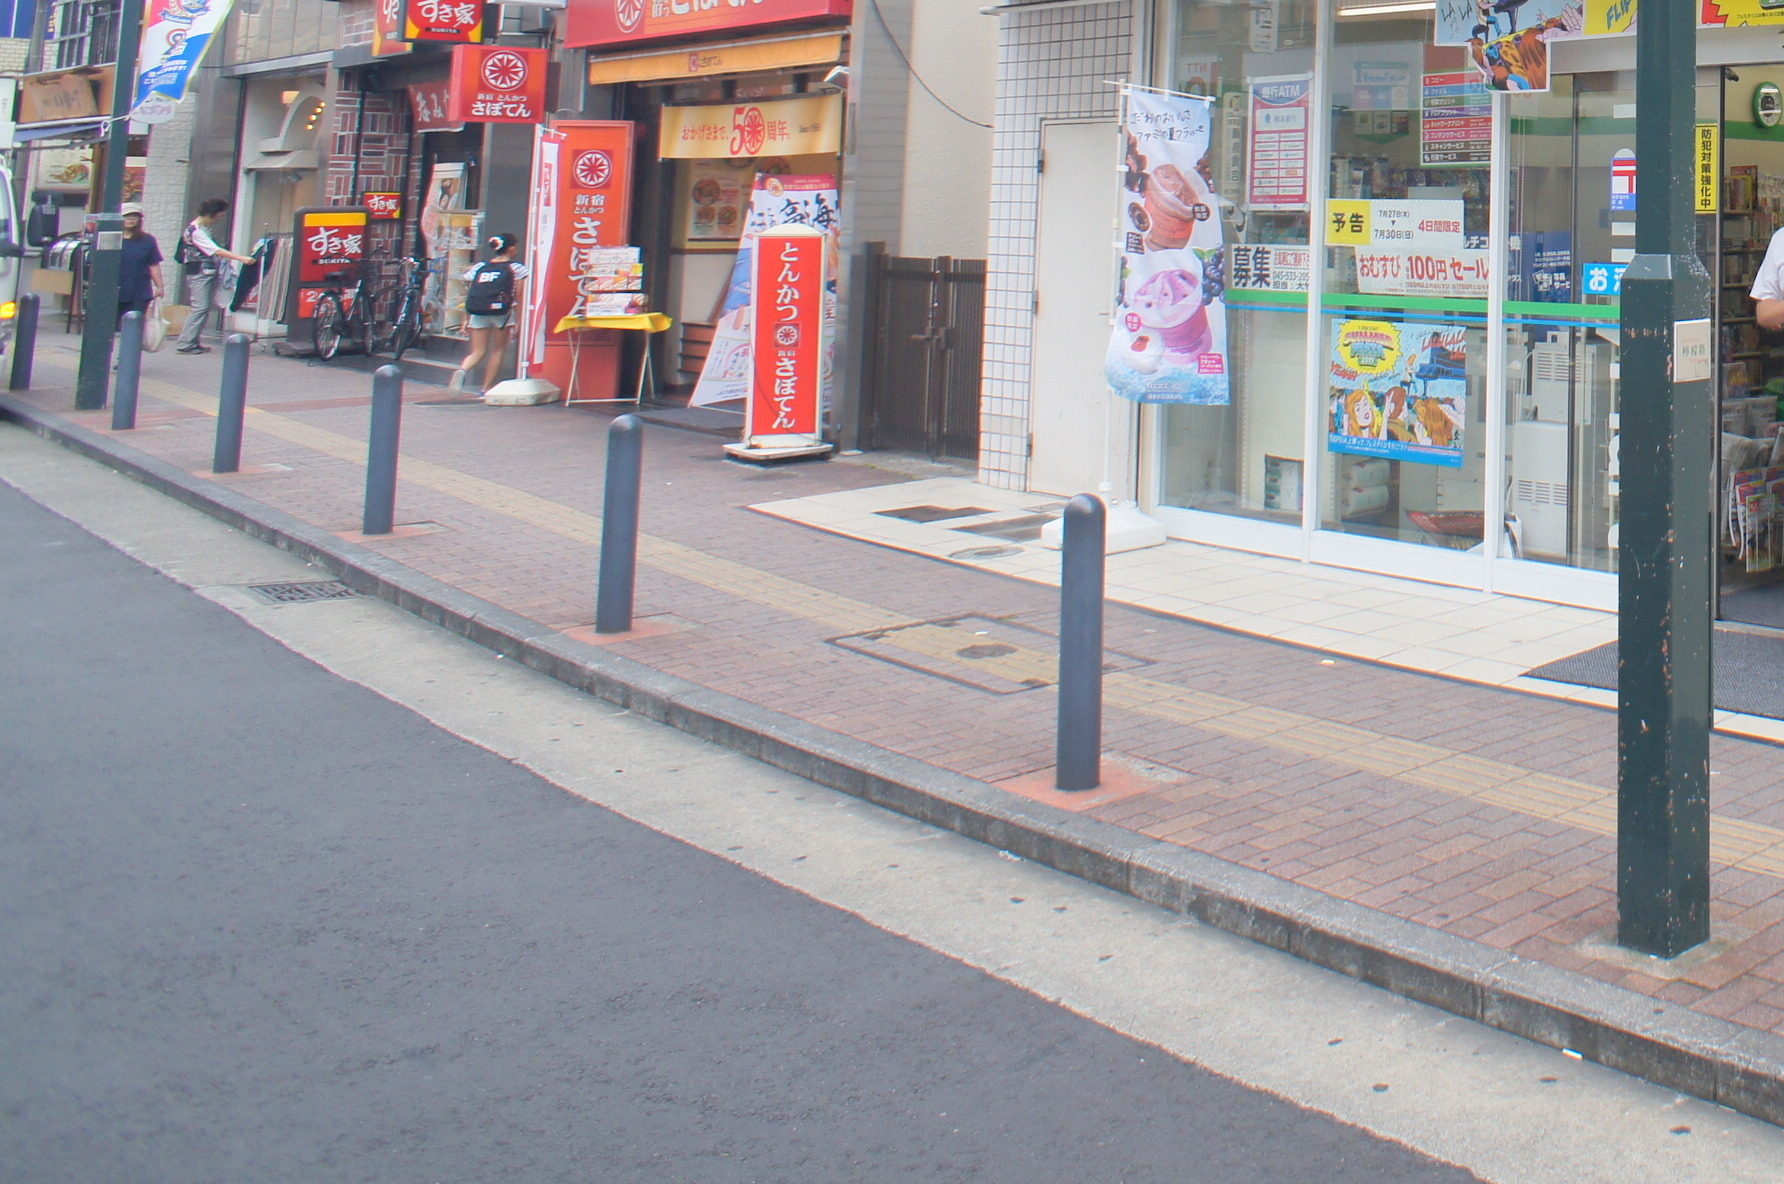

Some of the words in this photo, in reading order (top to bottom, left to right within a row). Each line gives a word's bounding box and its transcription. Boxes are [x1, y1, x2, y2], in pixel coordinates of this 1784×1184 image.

[1262, 84, 1300, 99] 銀行ATM
[471, 101, 531, 117] さぼてん
[1700, 128, 1712, 209] 防犯対策強化中
[575, 194, 605, 206] 新宿
[1332, 212, 1365, 233] 予告
[1418, 220, 1461, 233] 4日間限定
[307, 227, 362, 256] すき家
[479, 271, 501, 283] BF
[1233, 246, 1271, 288] 募集
[1359, 254, 1402, 279] おむすび
[1407, 255, 1449, 281] 100円
[777, 242, 800, 322] とんかつ
[771, 357, 798, 430] さぼてん
